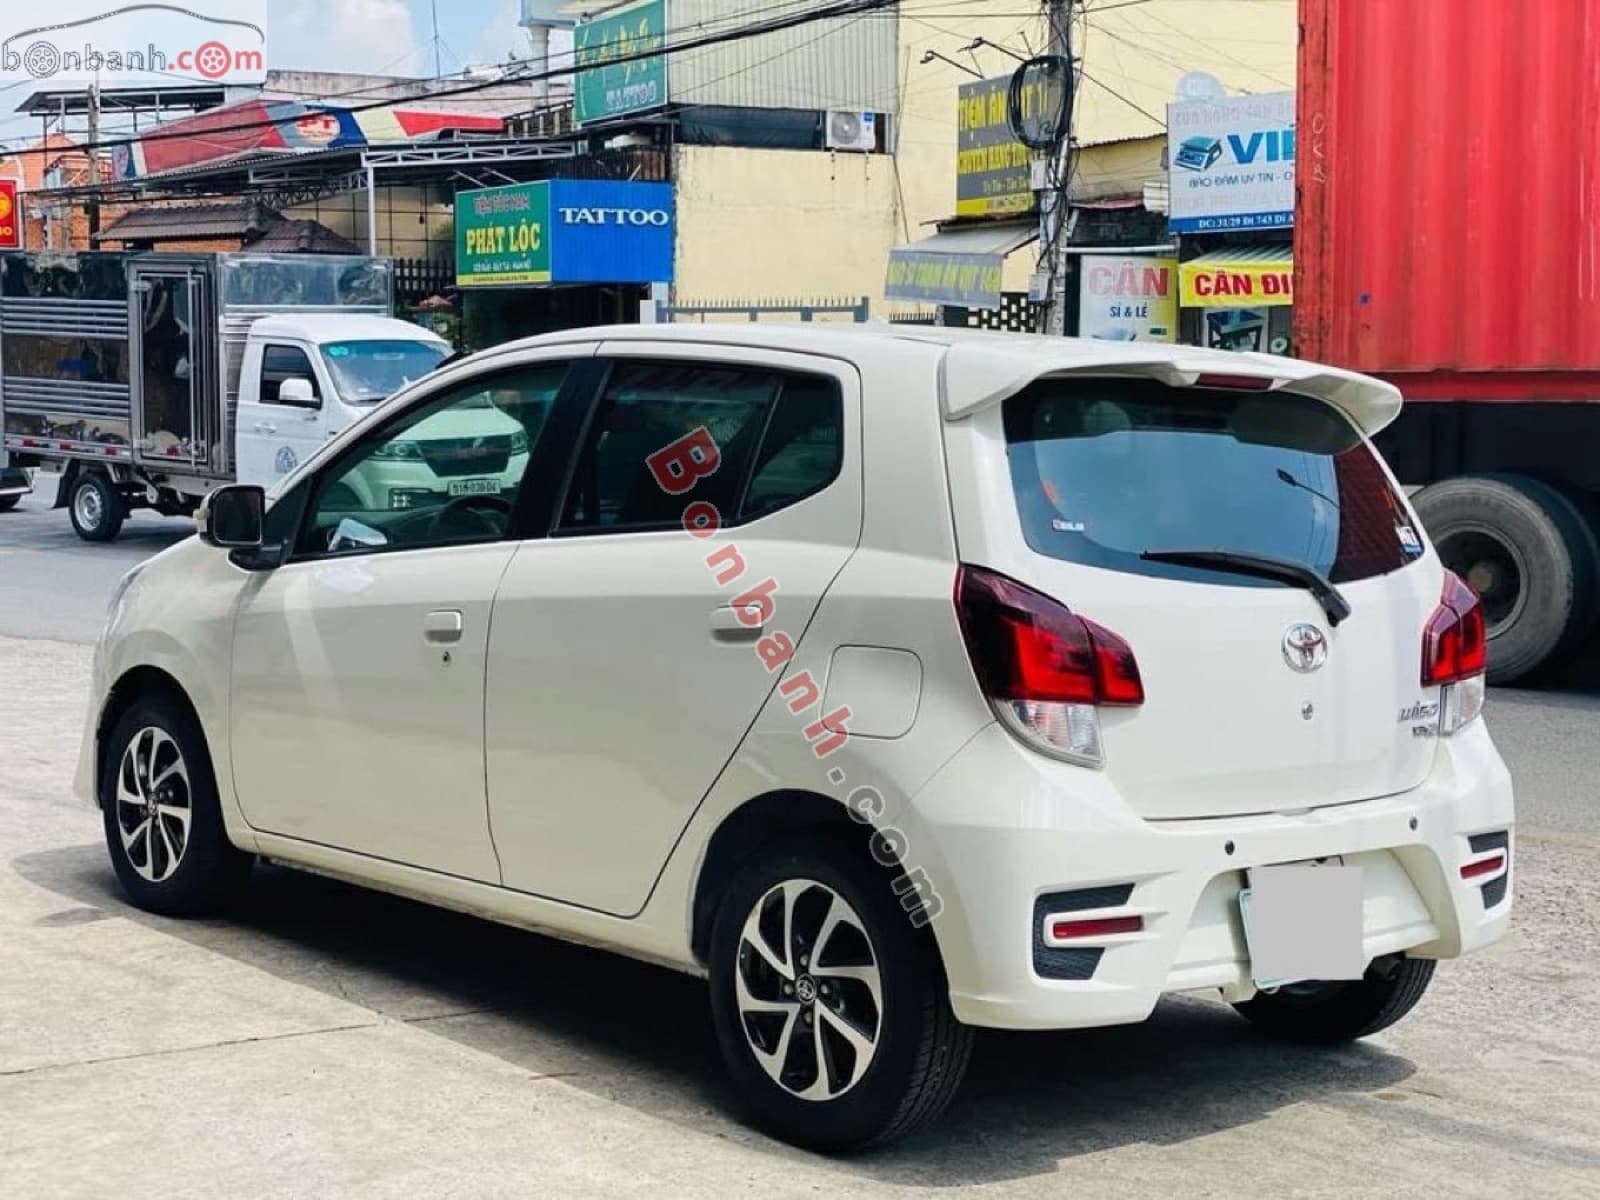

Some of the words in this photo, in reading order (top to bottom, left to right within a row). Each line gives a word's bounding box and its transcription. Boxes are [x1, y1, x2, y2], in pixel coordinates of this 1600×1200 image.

[606, 80, 656, 111] TATTOO
[559, 207, 669, 226] TATTOO
[466, 222, 504, 255] PHÁT
[508, 218, 541, 257] LỘC
[1088, 261, 1169, 297] CÂN
[1194, 270, 1252, 296] CÂN
[1124, 306, 1133, 317] &
